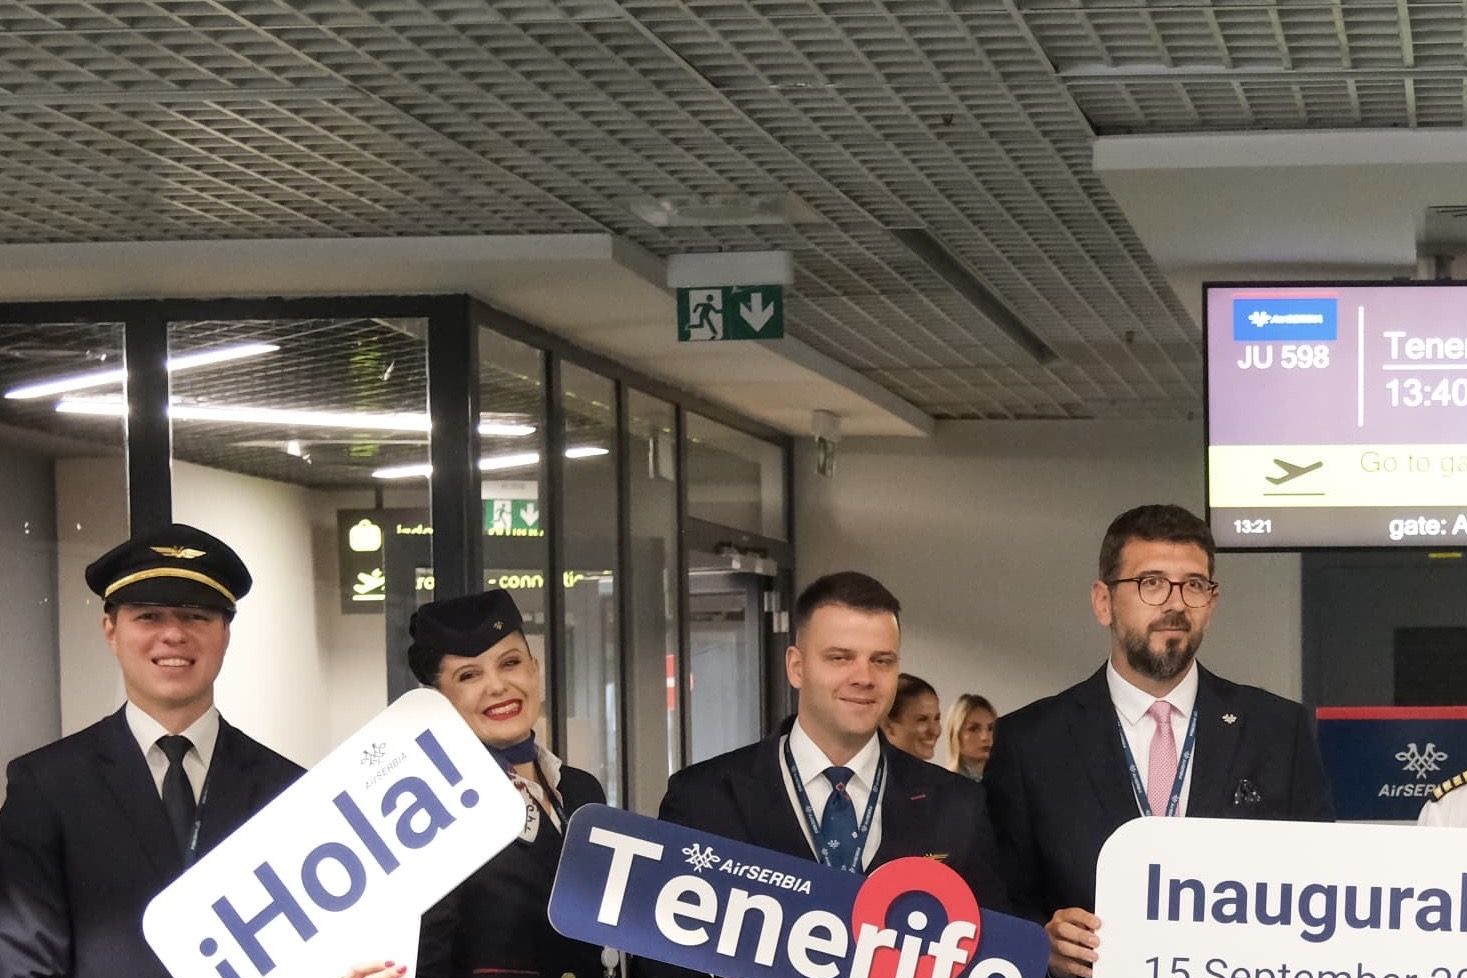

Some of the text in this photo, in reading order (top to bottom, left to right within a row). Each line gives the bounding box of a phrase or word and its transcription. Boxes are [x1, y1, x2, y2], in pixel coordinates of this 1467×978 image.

[1237, 345, 1330, 369] JU 598
[1360, 451, 1398, 474] Go
[1408, 454, 1430, 474] to
[1233, 519, 1272, 534] 13:21
[1388, 516, 1446, 541] gate:
[365, 752, 408, 790] AirSERBIA
[719, 858, 812, 895] AirSERBIA
